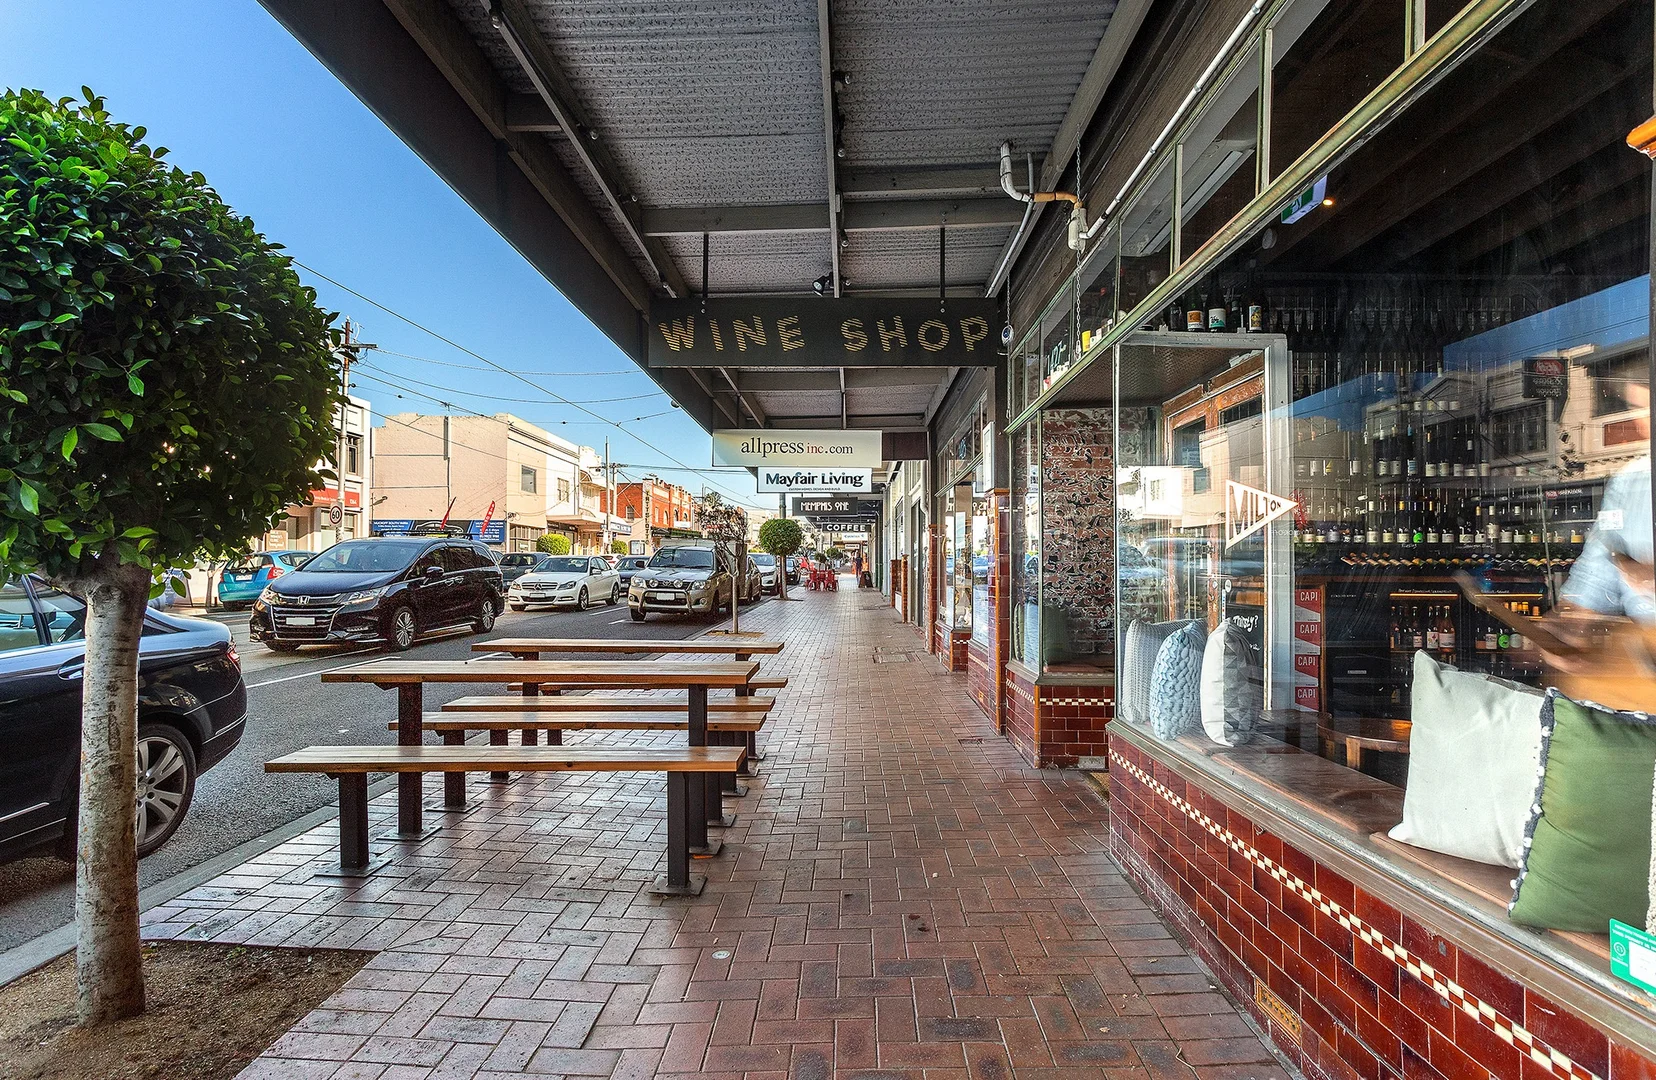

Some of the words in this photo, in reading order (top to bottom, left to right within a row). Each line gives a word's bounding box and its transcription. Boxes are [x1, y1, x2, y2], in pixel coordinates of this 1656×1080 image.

[658, 315, 805, 352] WINE
[841, 315, 989, 352] SHOP
[741, 437, 804, 457] allpress
[766, 472, 818, 487] Mayfair
[821, 472, 864, 487] Living
[800, 501, 833, 511] MEMPHIS
[332, 510, 340, 520] 60
[1229, 485, 1281, 541] MILTON
[826, 524, 866, 532] COFFEE
[1300, 591, 1318, 602] CAPI
[1299, 624, 1318, 634] CAPI
[1297, 656, 1316, 666] CAPI
[1297, 688, 1316, 698] CAPI
